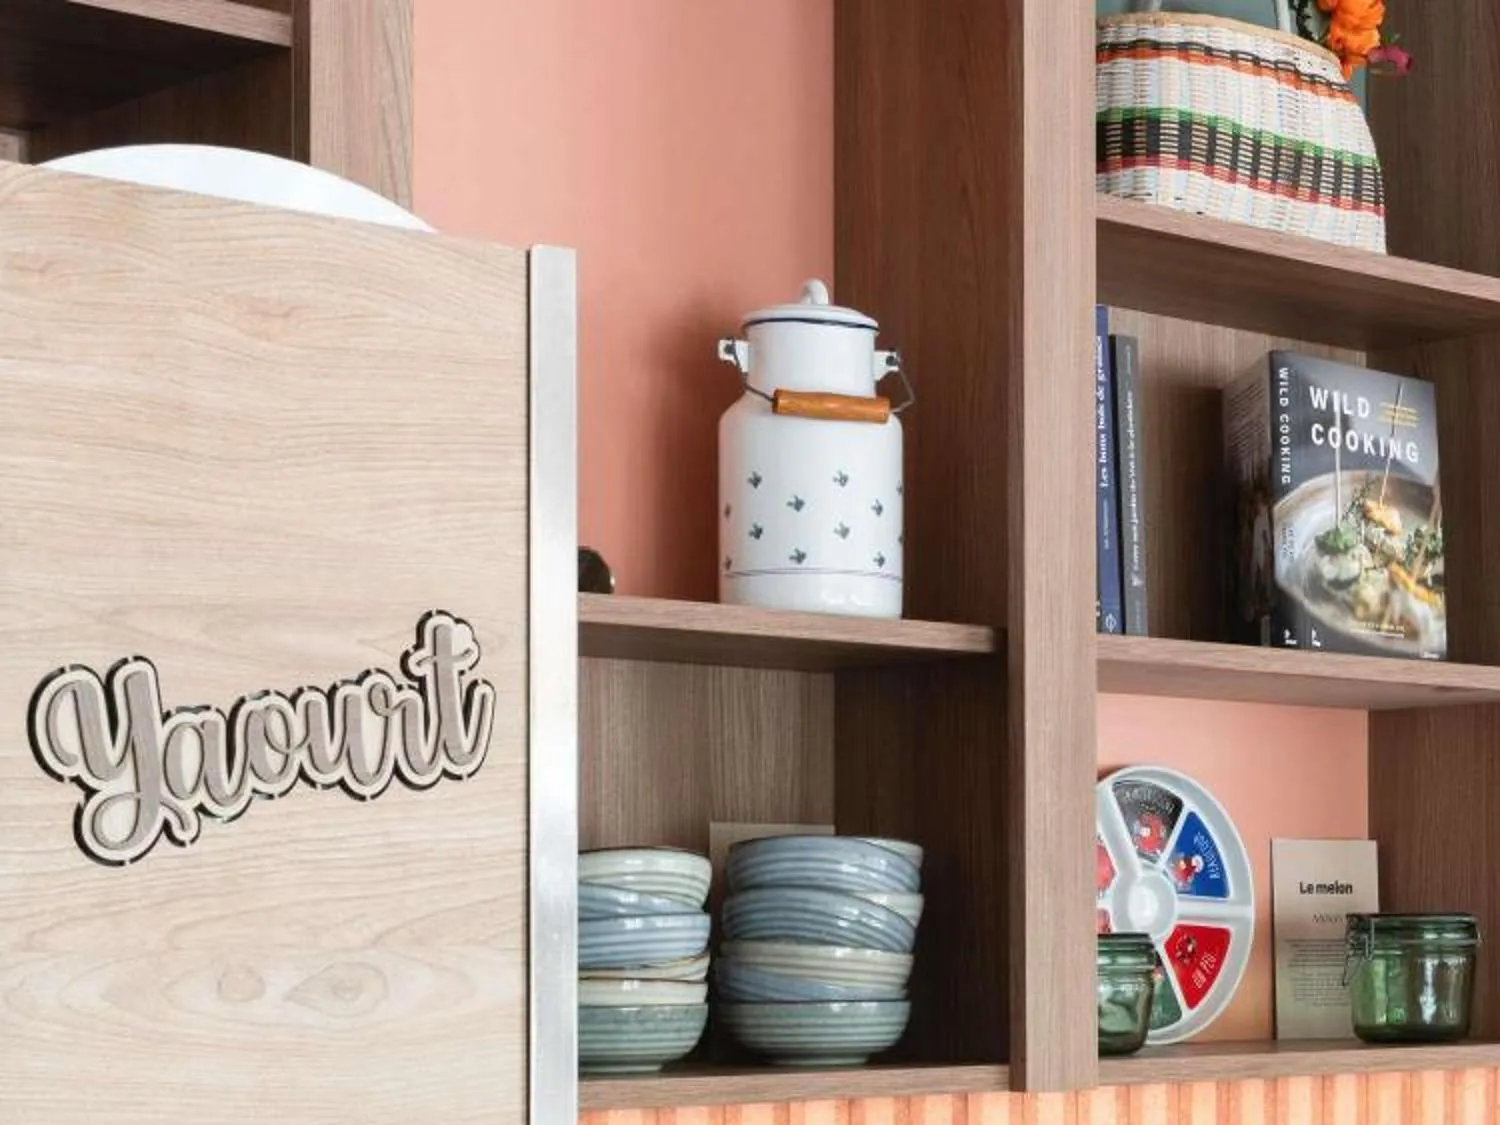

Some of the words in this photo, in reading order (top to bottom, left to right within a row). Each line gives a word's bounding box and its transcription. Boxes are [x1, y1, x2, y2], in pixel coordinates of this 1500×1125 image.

[1279, 367, 1290, 407] WILD
[1309, 385, 1370, 418] WILD
[1279, 413, 1292, 485] COOKING
[1310, 423, 1419, 463] COOKING
[27, 609, 495, 866] Yaourt
[1299, 881, 1314, 895] Le
[1316, 880, 1353, 895] melon
